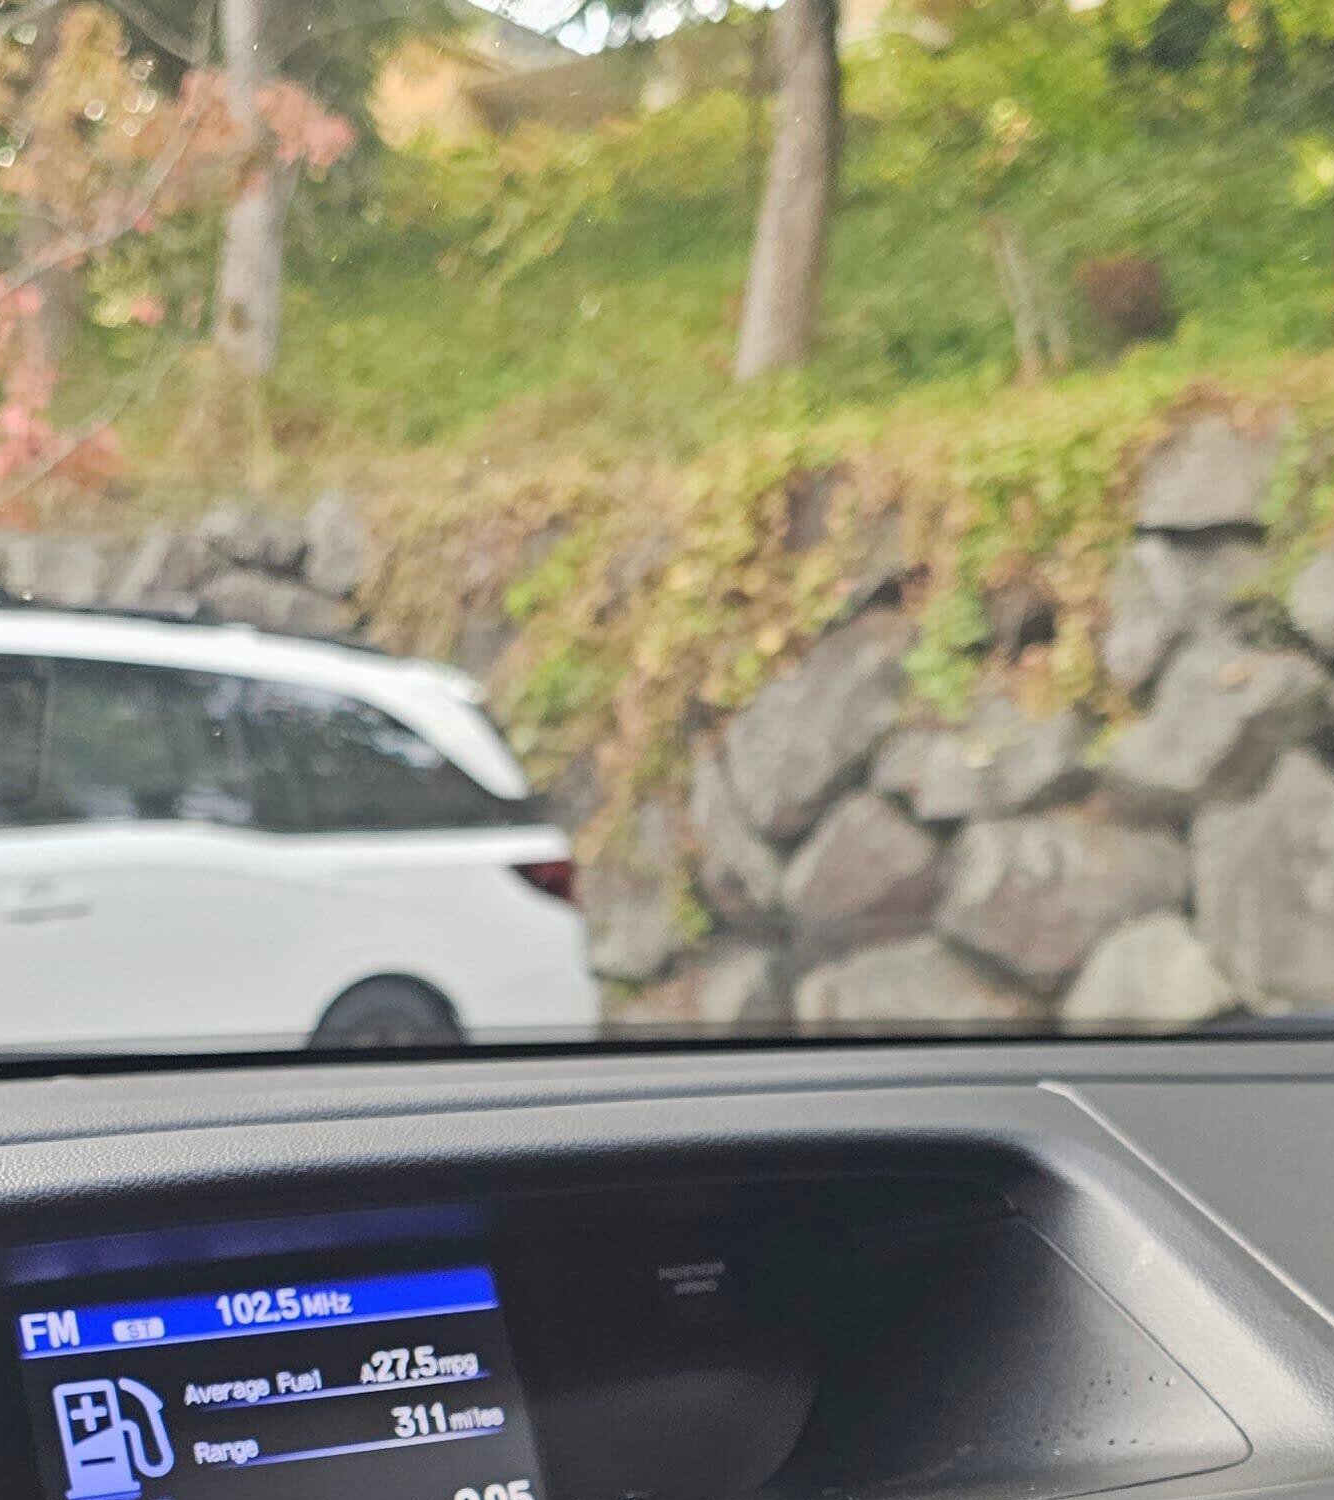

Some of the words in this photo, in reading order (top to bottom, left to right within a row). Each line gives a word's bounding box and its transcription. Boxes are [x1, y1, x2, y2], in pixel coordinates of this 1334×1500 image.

[20, 1310, 80, 1350] FM
[216, 1287, 300, 1326] 102.5
[300, 1291, 354, 1319] MHz
[184, 1377, 270, 1406] Average
[275, 1368, 323, 1395] Fuel
[193, 1438, 259, 1465] Range
[391, 1402, 447, 1438] 311
[448, 1406, 505, 1432] miles
